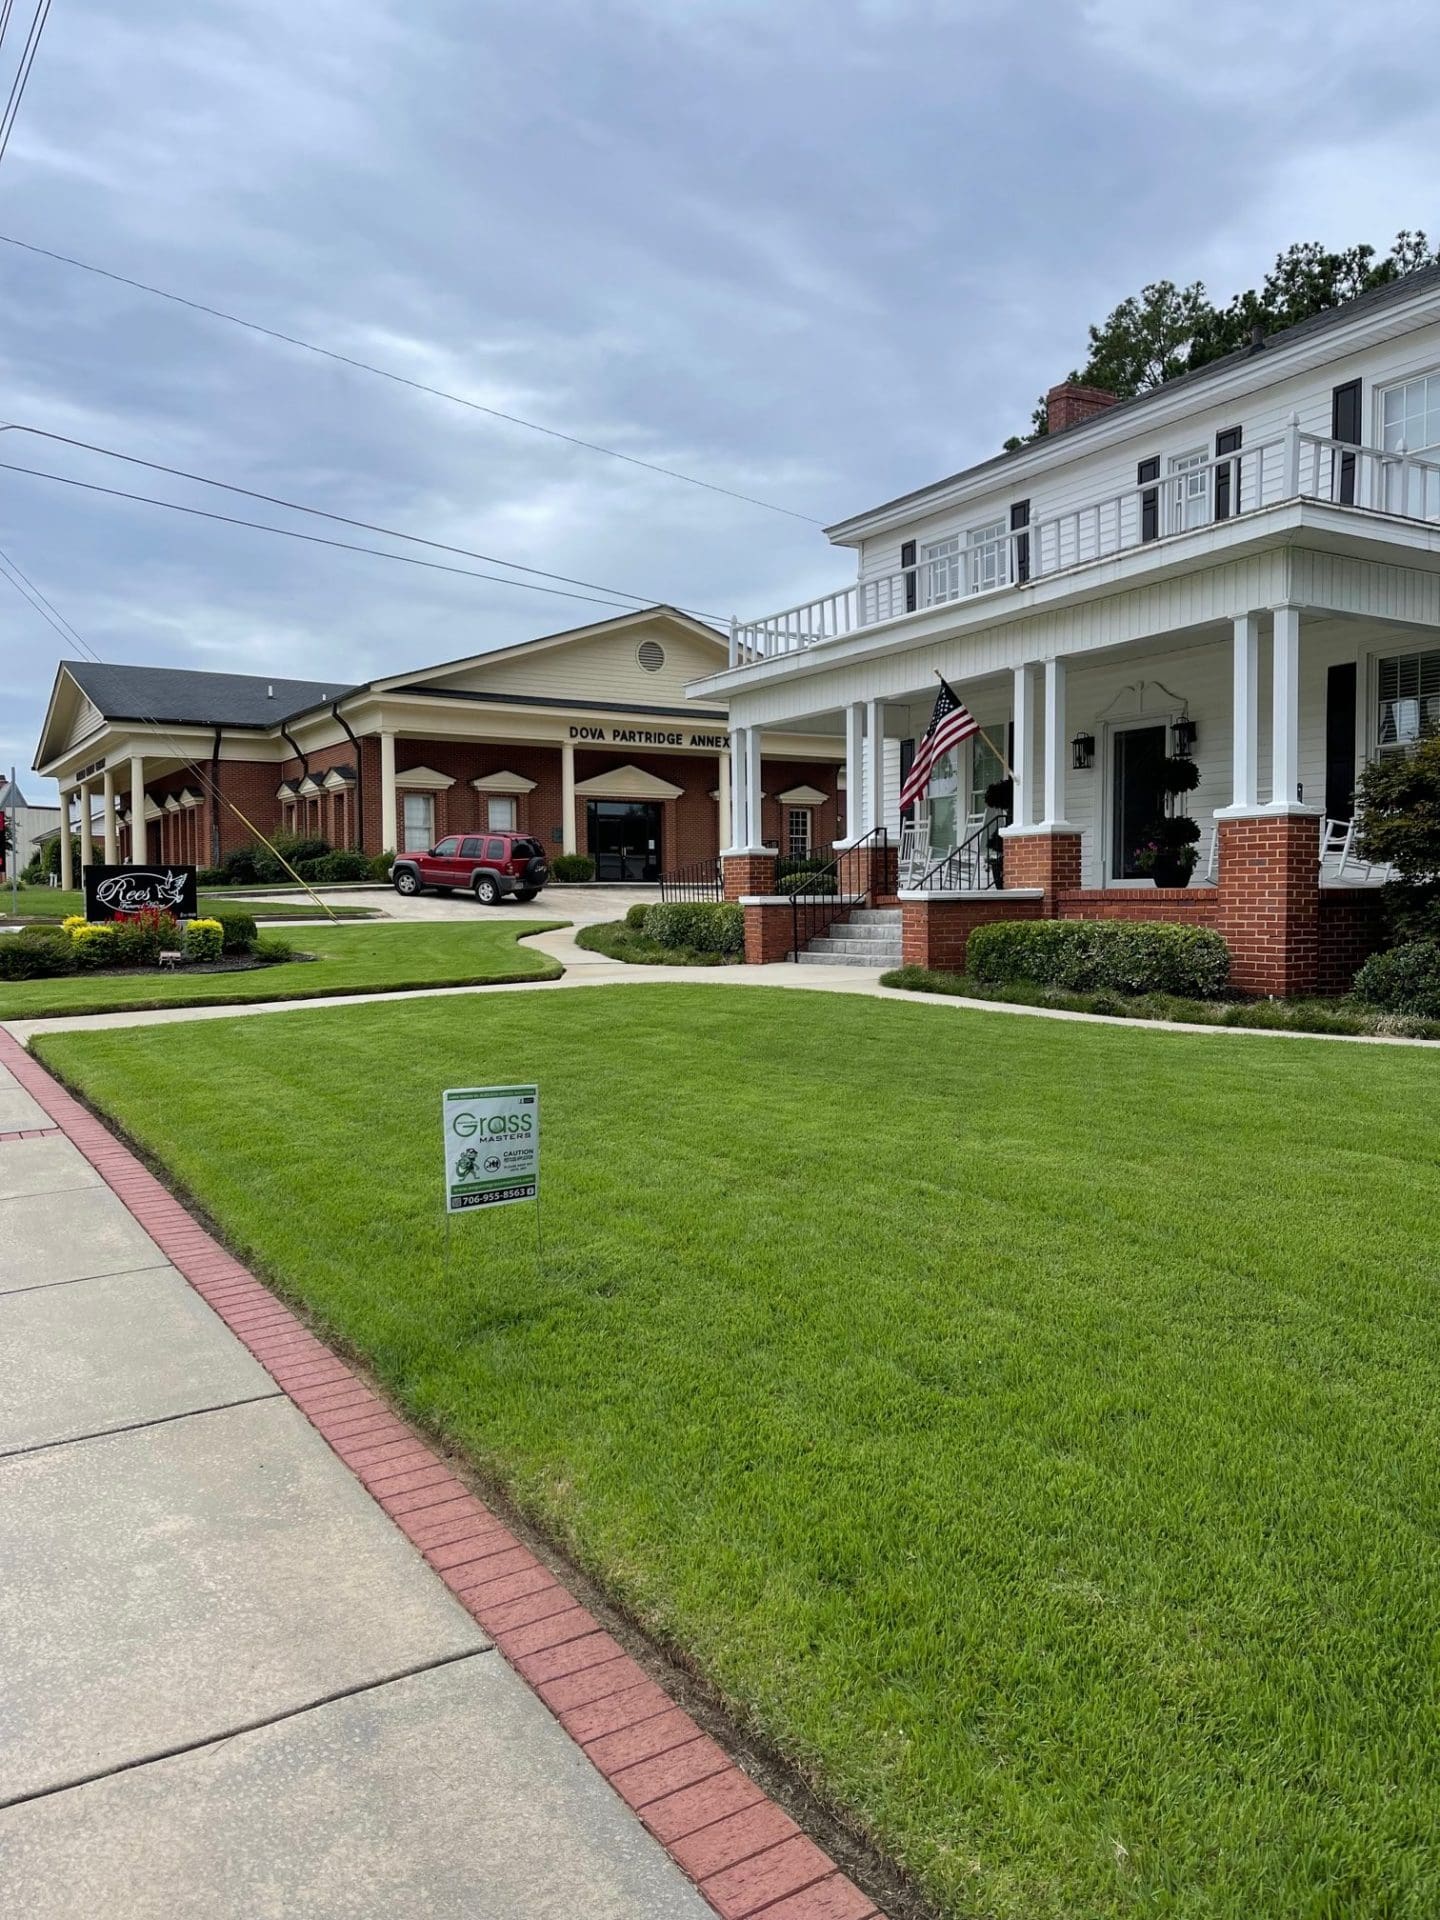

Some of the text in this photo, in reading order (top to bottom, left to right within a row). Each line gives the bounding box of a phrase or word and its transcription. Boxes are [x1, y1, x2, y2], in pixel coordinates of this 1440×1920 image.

[569, 727, 731, 748] DOVA PARTRIDGE ANNEX
[96, 878, 150, 901] Rees
[453, 1112, 532, 1138] Grass
[480, 1133, 531, 1143] MASTERS
[503, 1149, 534, 1157] CAUTION
[462, 1188, 526, 1206] 706-955-8563
